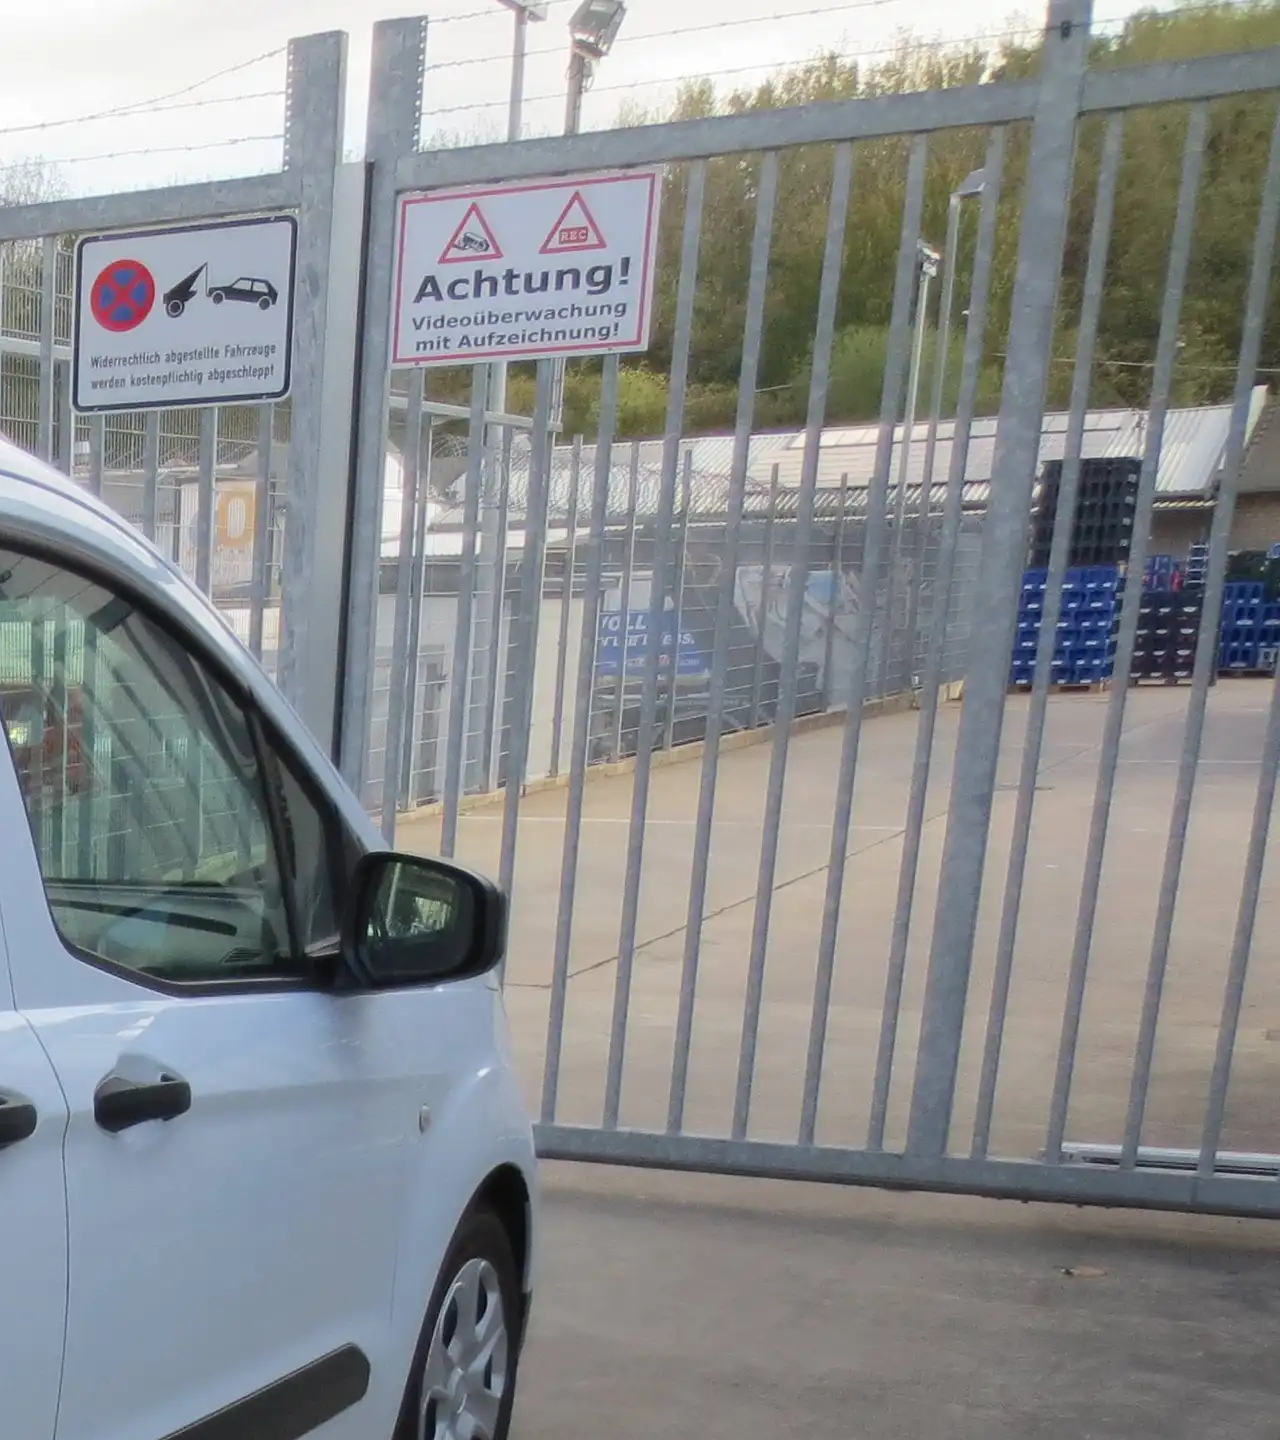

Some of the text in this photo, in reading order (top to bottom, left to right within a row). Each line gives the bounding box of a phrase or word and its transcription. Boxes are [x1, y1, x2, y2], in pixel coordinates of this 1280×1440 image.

[560, 229, 587, 241] REC
[412, 256, 631, 303] Achtung!
[412, 302, 628, 331] Videoüberwachung
[415, 322, 619, 351] mit Aufzeichnung!
[90, 344, 276, 369] Widerrechtlich abgestellte Fahrzeuge
[91, 364, 275, 390] werden kostenpflichtig abgeschleppt
